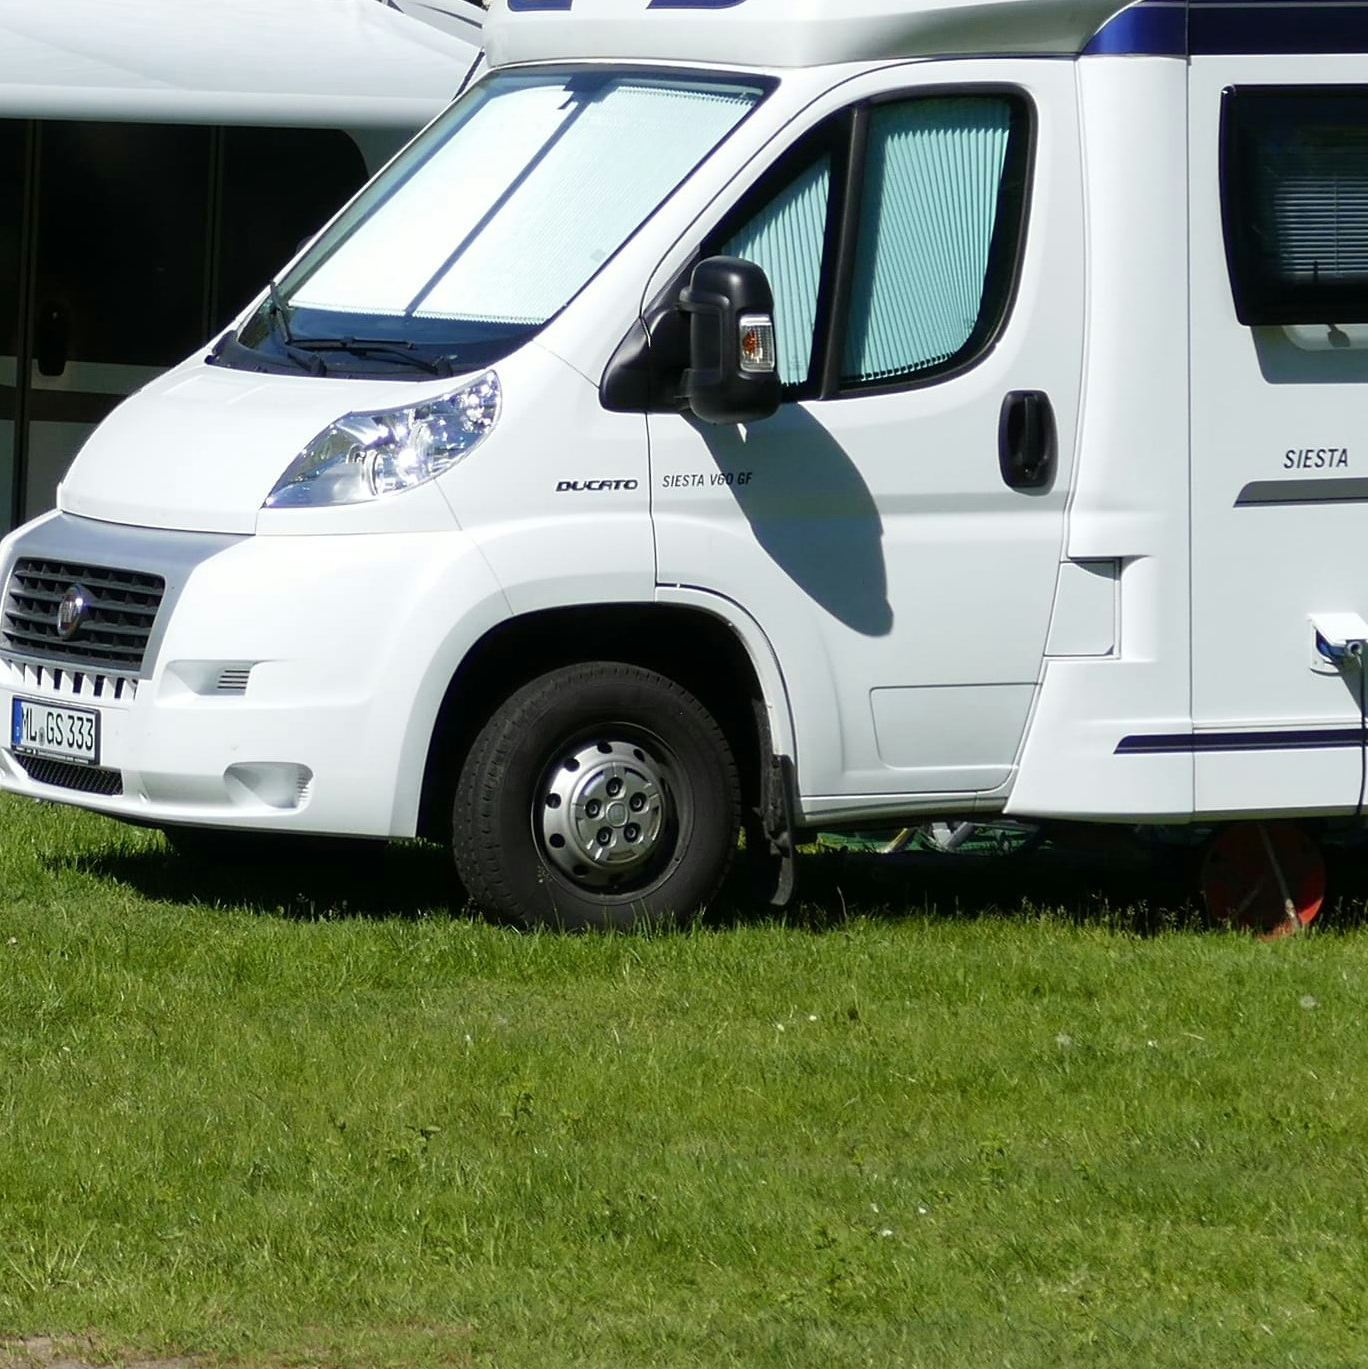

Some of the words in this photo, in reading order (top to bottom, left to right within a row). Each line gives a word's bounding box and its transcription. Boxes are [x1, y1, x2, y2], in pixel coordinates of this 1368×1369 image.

[1283, 448, 1348, 469] SIESTA
[556, 479, 639, 492] DUCATO
[662, 474, 705, 488] SIESTA
[710, 473, 734, 487] V60
[737, 472, 753, 485] GF
[21, 707, 37, 742] ML
[46, 712, 64, 746] GS
[67, 715, 94, 751] 333
